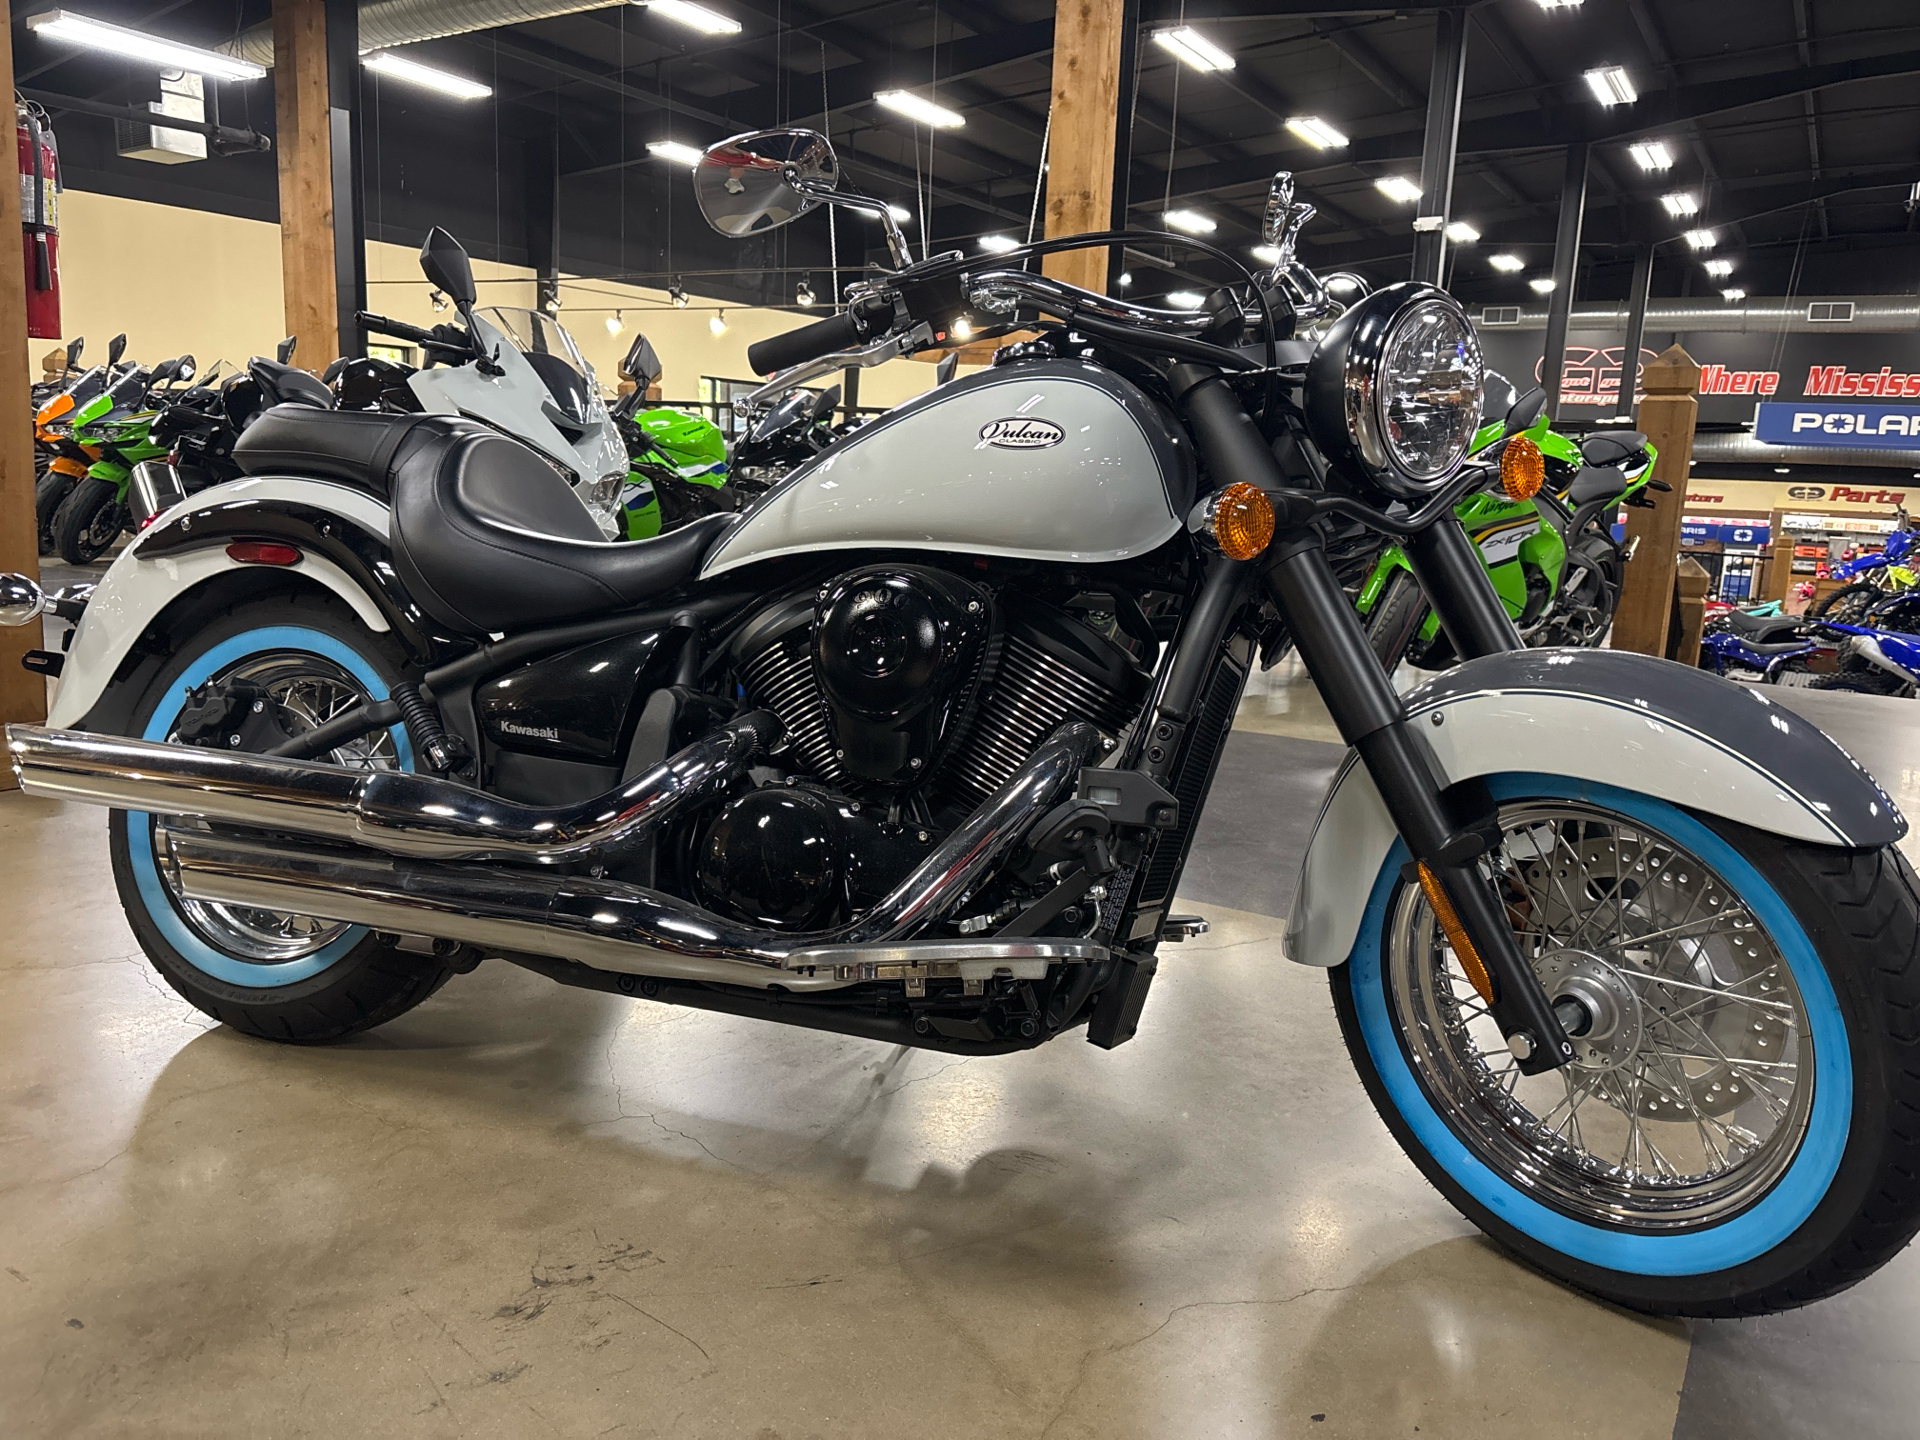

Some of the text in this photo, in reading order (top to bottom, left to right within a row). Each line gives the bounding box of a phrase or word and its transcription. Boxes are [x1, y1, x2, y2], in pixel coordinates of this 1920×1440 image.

[988, 422, 1060, 440] Vulcan
[1829, 486, 1906, 504] Parts
[500, 720, 559, 739] Kawasaki
